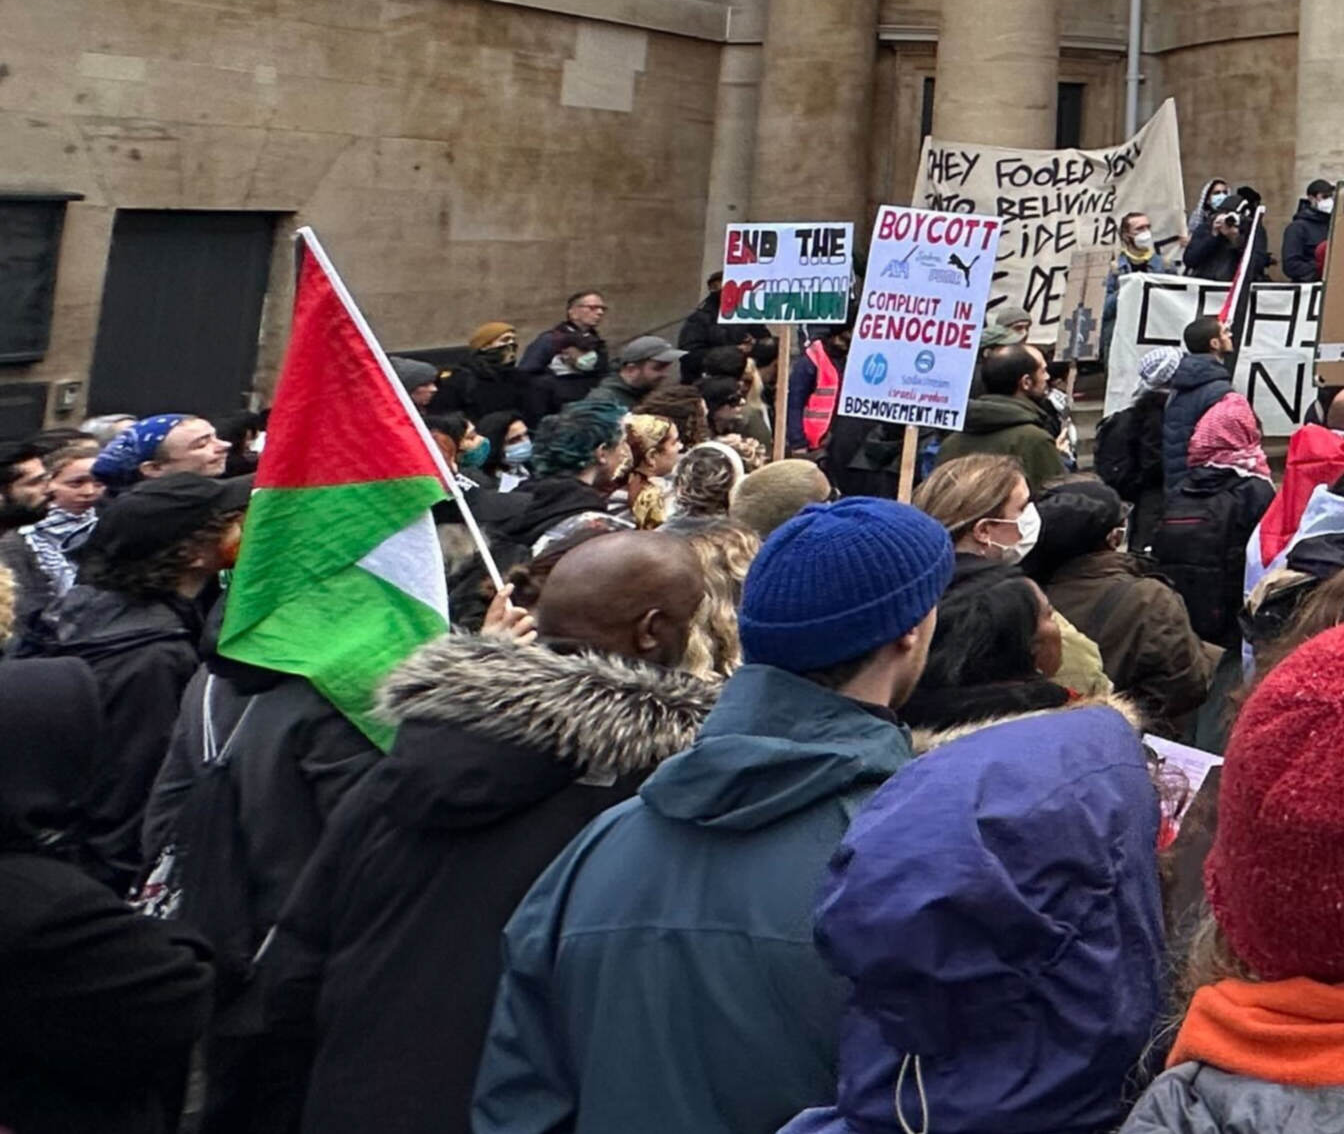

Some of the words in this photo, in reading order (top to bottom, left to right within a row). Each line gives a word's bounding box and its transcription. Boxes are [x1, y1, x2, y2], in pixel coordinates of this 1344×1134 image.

[996, 156, 1095, 189] FOOLED
[726, 229, 778, 265] END
[794, 227, 846, 266] THE
[878, 210, 999, 250] BOYCOTT
[720, 276, 849, 321] OCCUPATION
[867, 290, 941, 317] COMPLICIT
[953, 300, 973, 321] IN
[858, 313, 977, 350] GENOCIDE
[862, 352, 888, 385] hp
[844, 396, 960, 427] BDSMOVEMENT.NET
